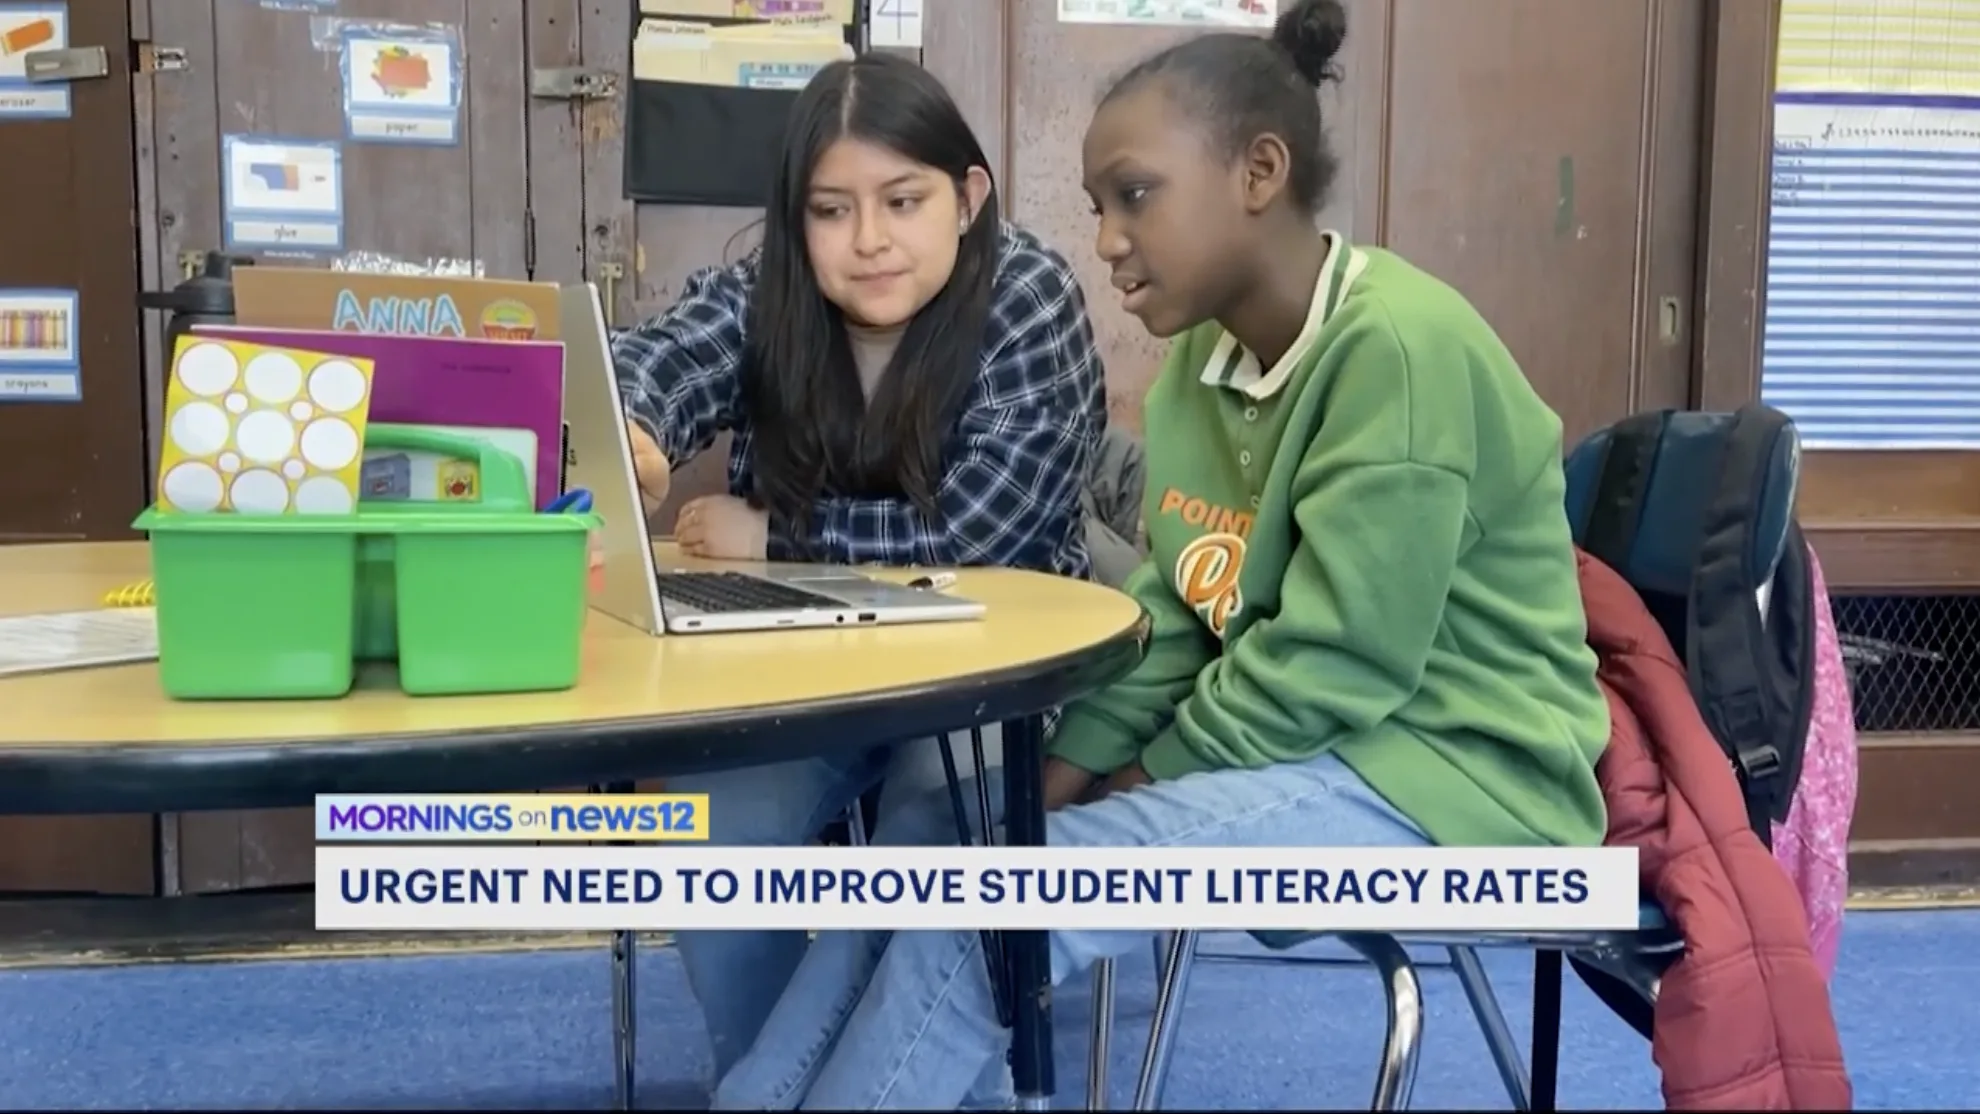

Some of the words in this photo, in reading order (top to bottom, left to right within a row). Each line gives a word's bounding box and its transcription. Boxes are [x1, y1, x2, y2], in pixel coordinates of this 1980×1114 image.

[386, 122, 418, 136] paper
[274, 224, 297, 242] glue
[332, 289, 466, 338] ANNA
[5, 379, 48, 394] crayons
